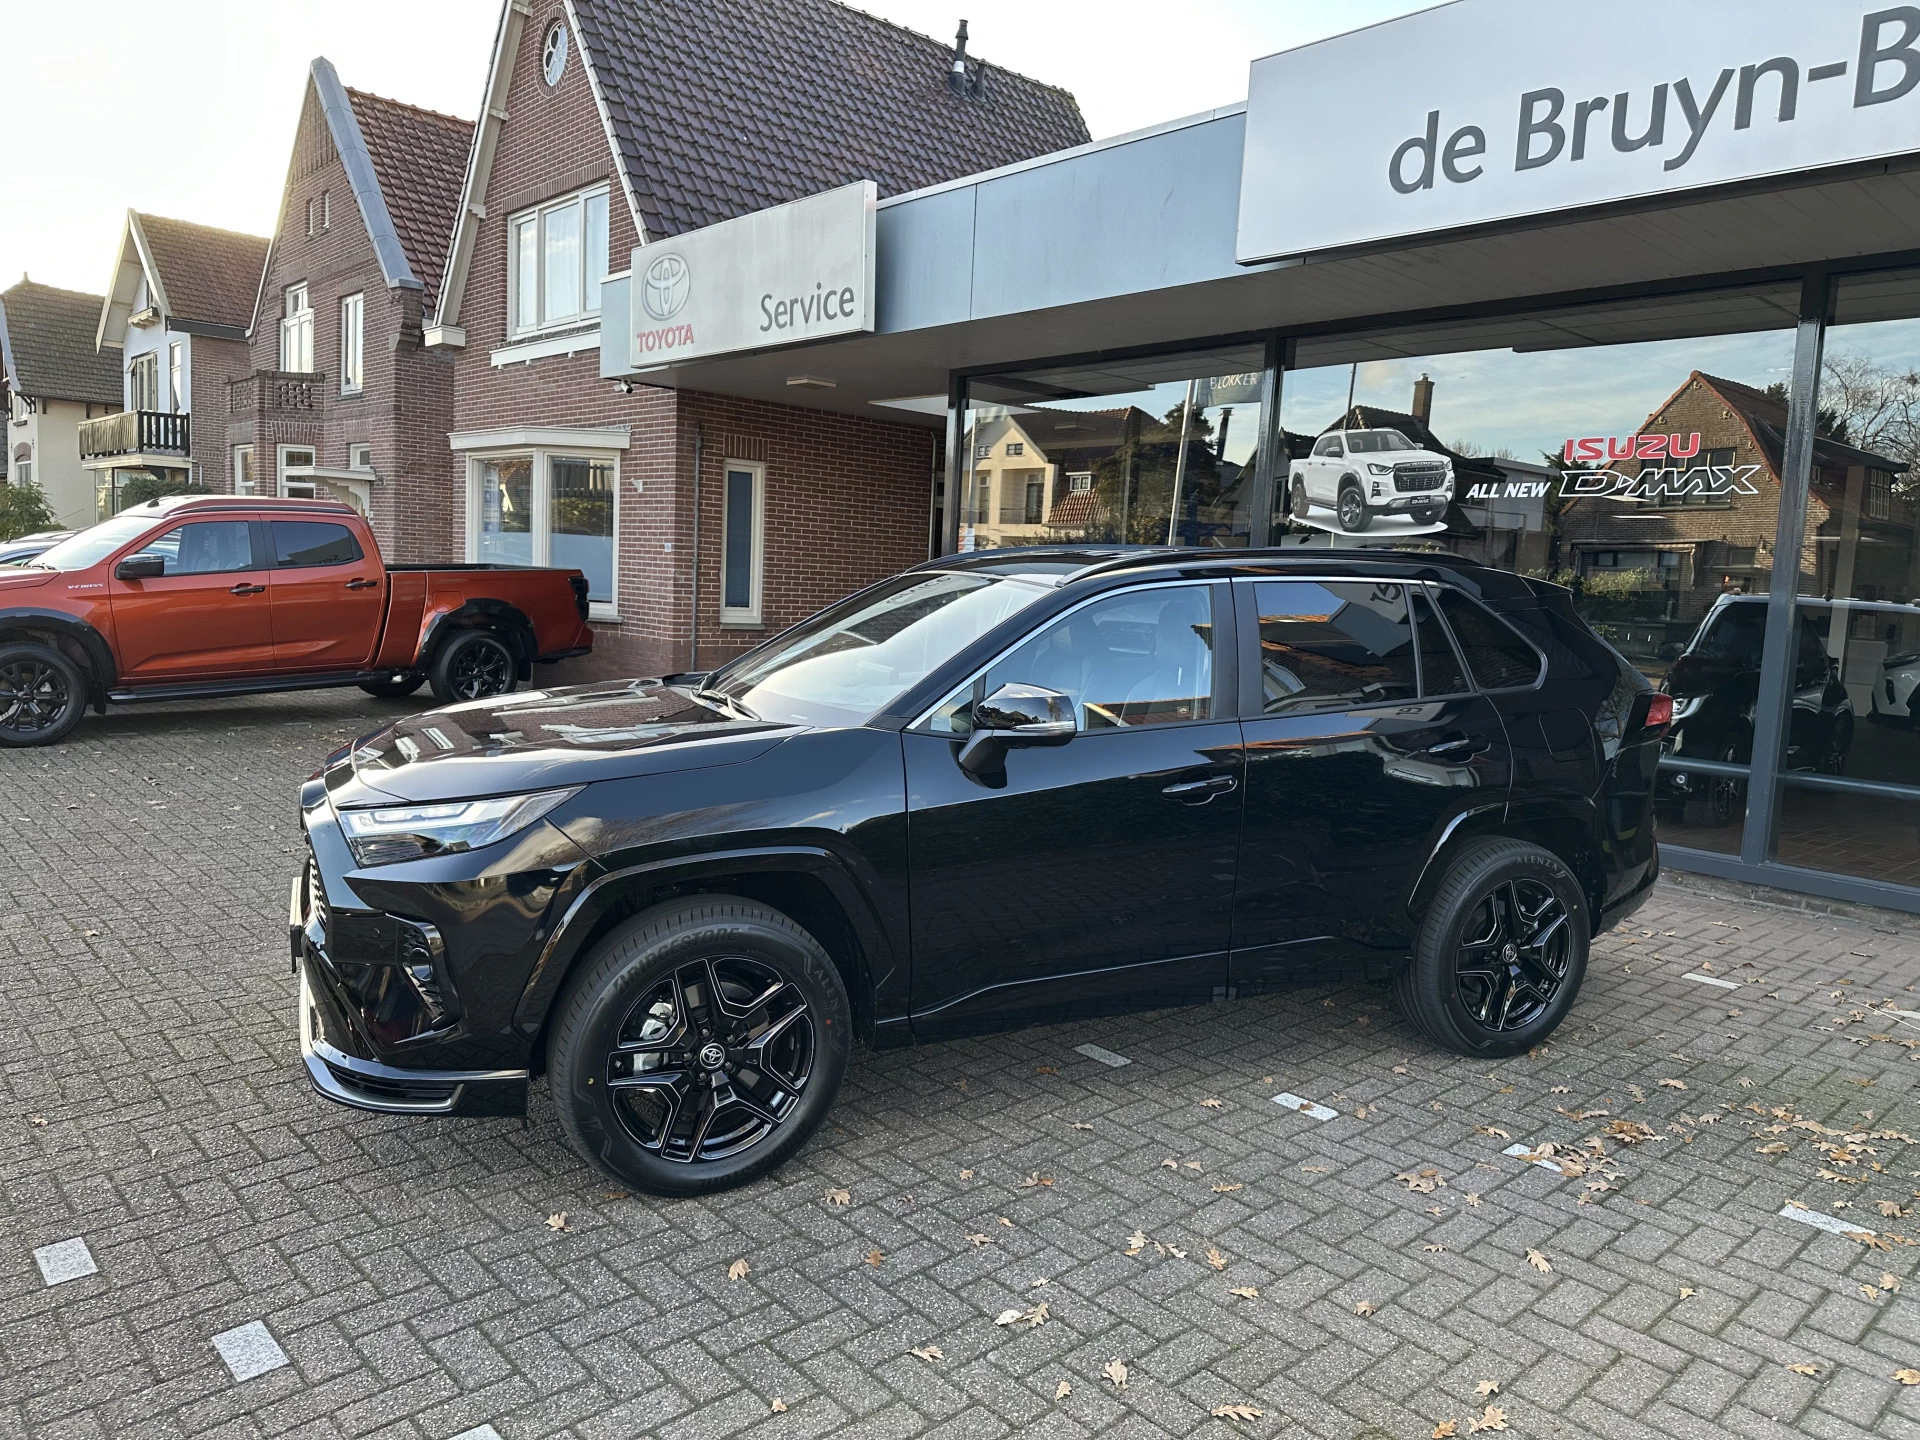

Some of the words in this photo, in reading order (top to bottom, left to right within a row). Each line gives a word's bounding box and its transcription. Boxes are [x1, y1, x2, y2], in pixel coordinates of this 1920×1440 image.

[1388, 110, 1487, 195] de
[1514, 5, 1920, 173] Bruyn-B
[759, 282, 855, 332] Service
[636, 323, 695, 354] TOYOTA
[1210, 372, 1258, 390] BLOKKER
[1563, 431, 1702, 463] ISUZU
[1465, 483, 1500, 500] ALL
[1503, 481, 1552, 499] NEW
[1558, 464, 1762, 498] D-MAX
[1516, 855, 1558, 871] ALENZA
[813, 969, 845, 1037] ALENZA
